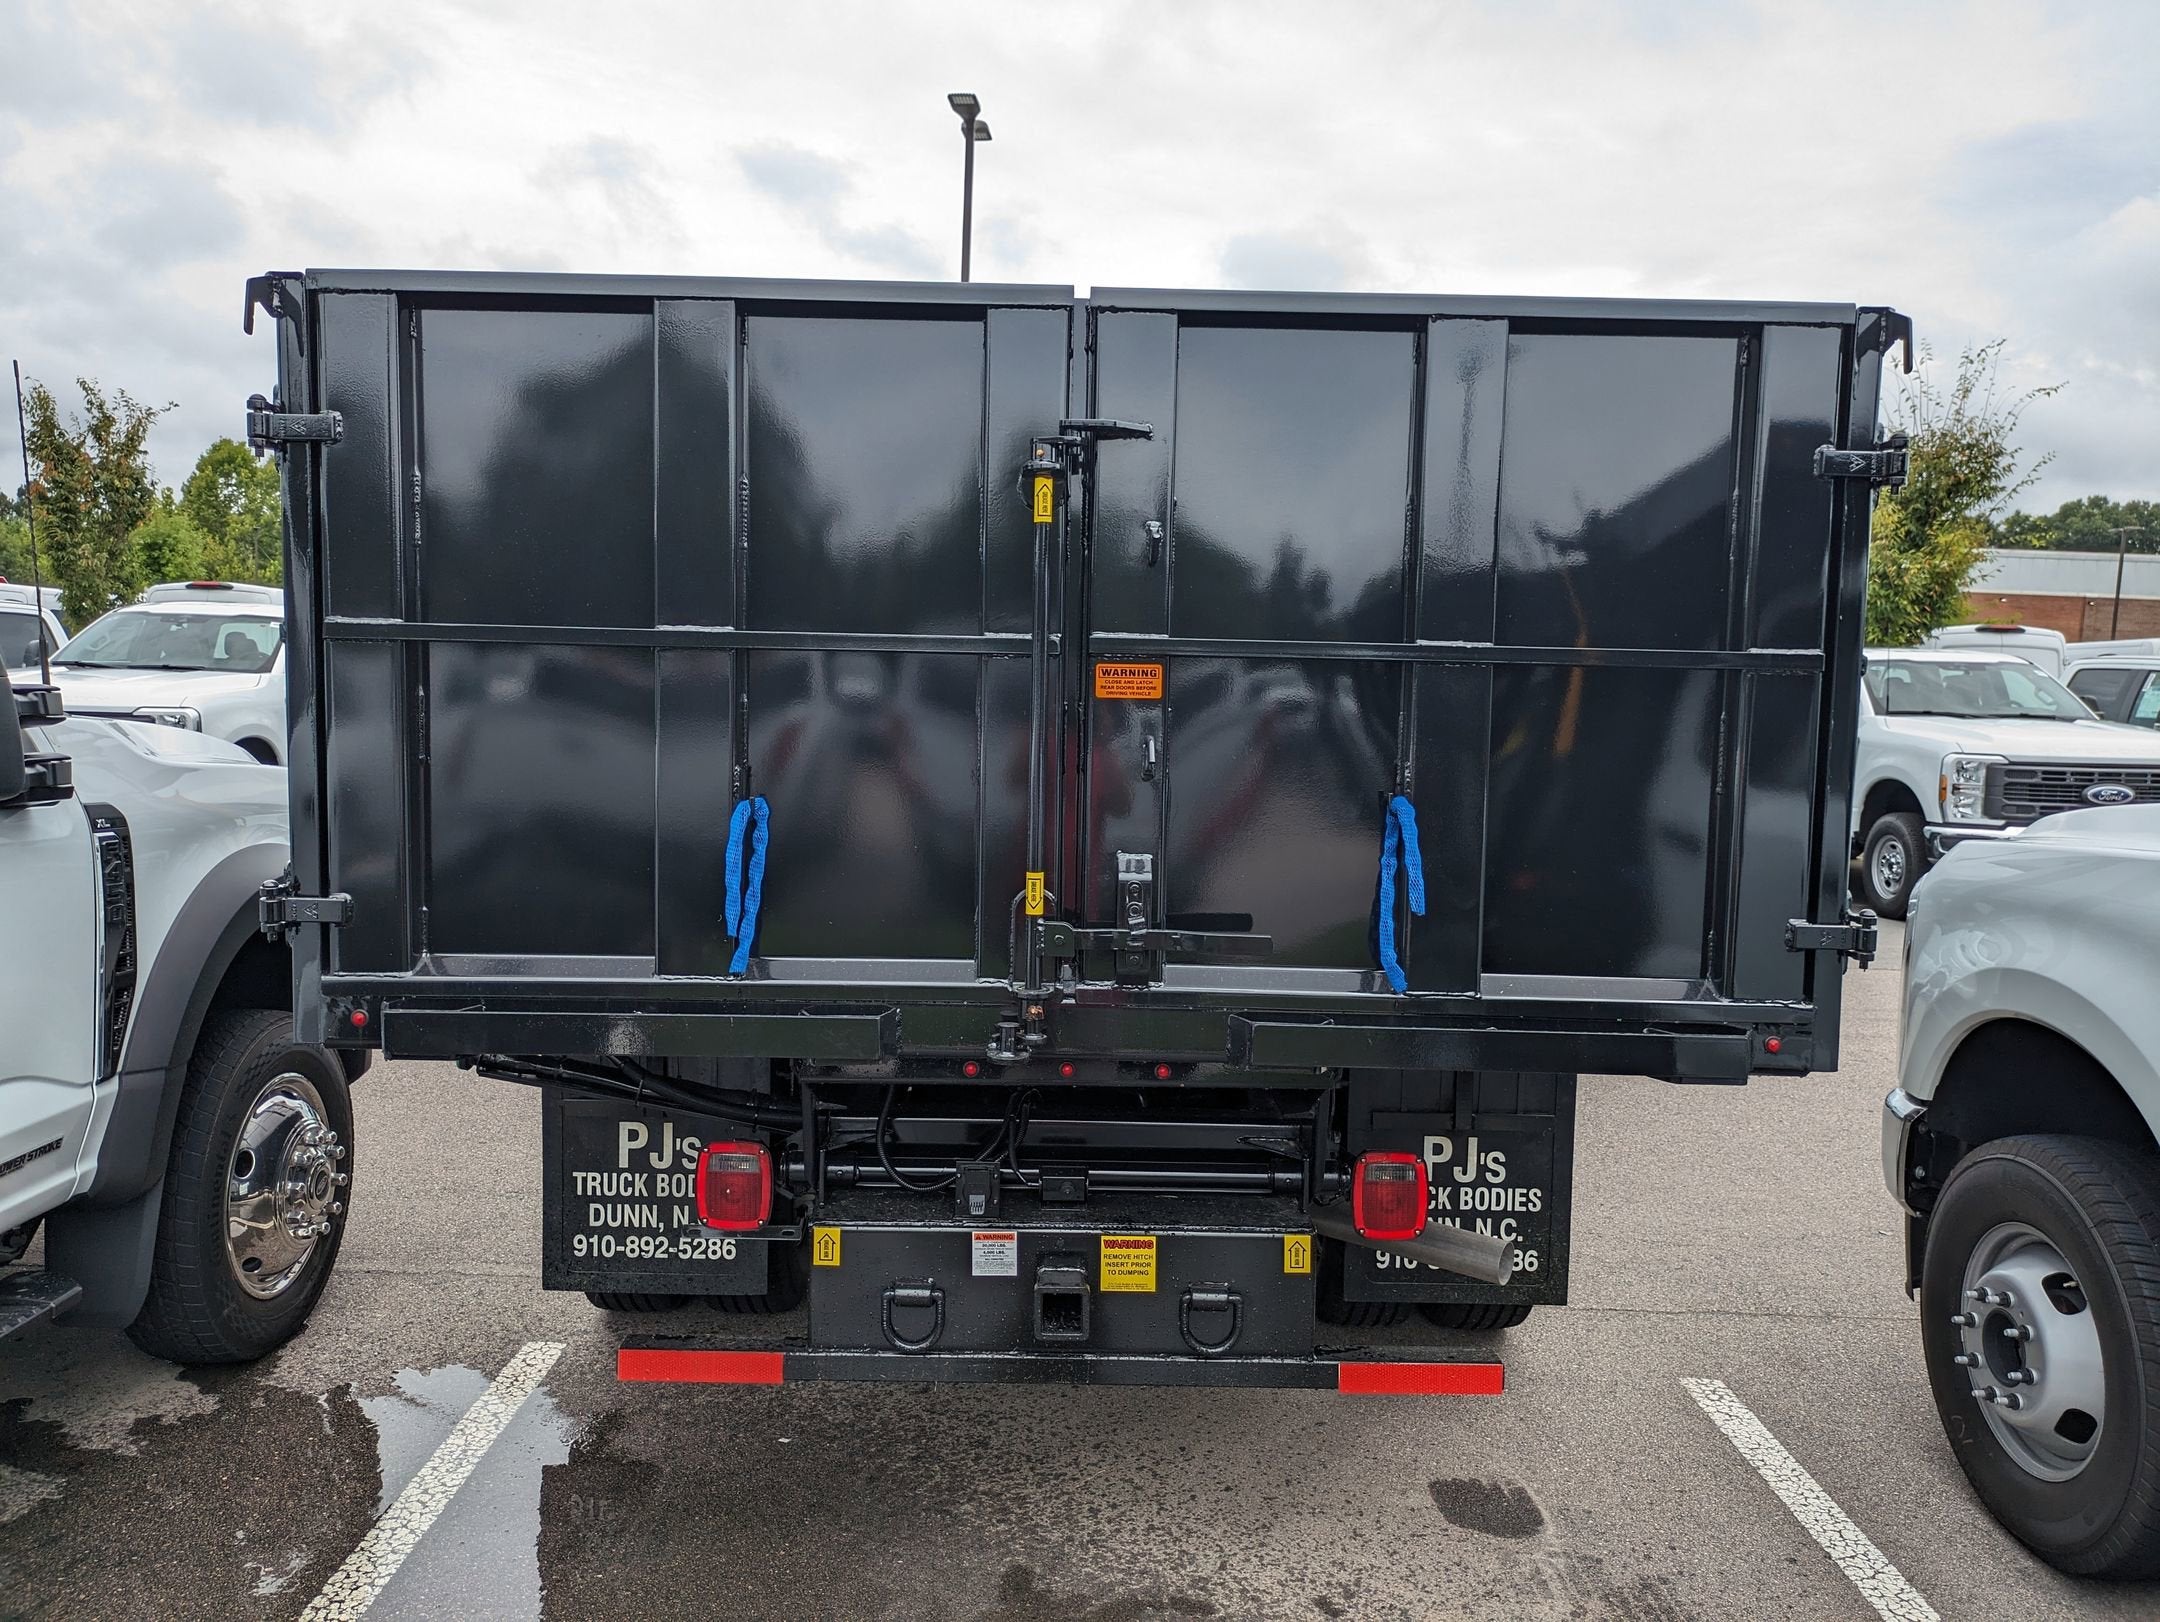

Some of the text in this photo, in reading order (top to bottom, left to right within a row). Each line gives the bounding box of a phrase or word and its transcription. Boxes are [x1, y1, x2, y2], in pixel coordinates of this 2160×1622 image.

[1101, 668, 1157, 678] WARNING
[2098, 789, 2124, 801] Ford
[95, 818, 111, 828] XL
[27, 1136, 64, 1162] STROKE
[572, 1171, 649, 1197] TRUCK
[1459, 1186, 1543, 1212] BODIES
[588, 1203, 665, 1233] DUNN,
[1475, 1217, 1524, 1242] N.C.
[572, 1234, 737, 1260] 910-892-5286
[1103, 1239, 1154, 1249] WARNING
